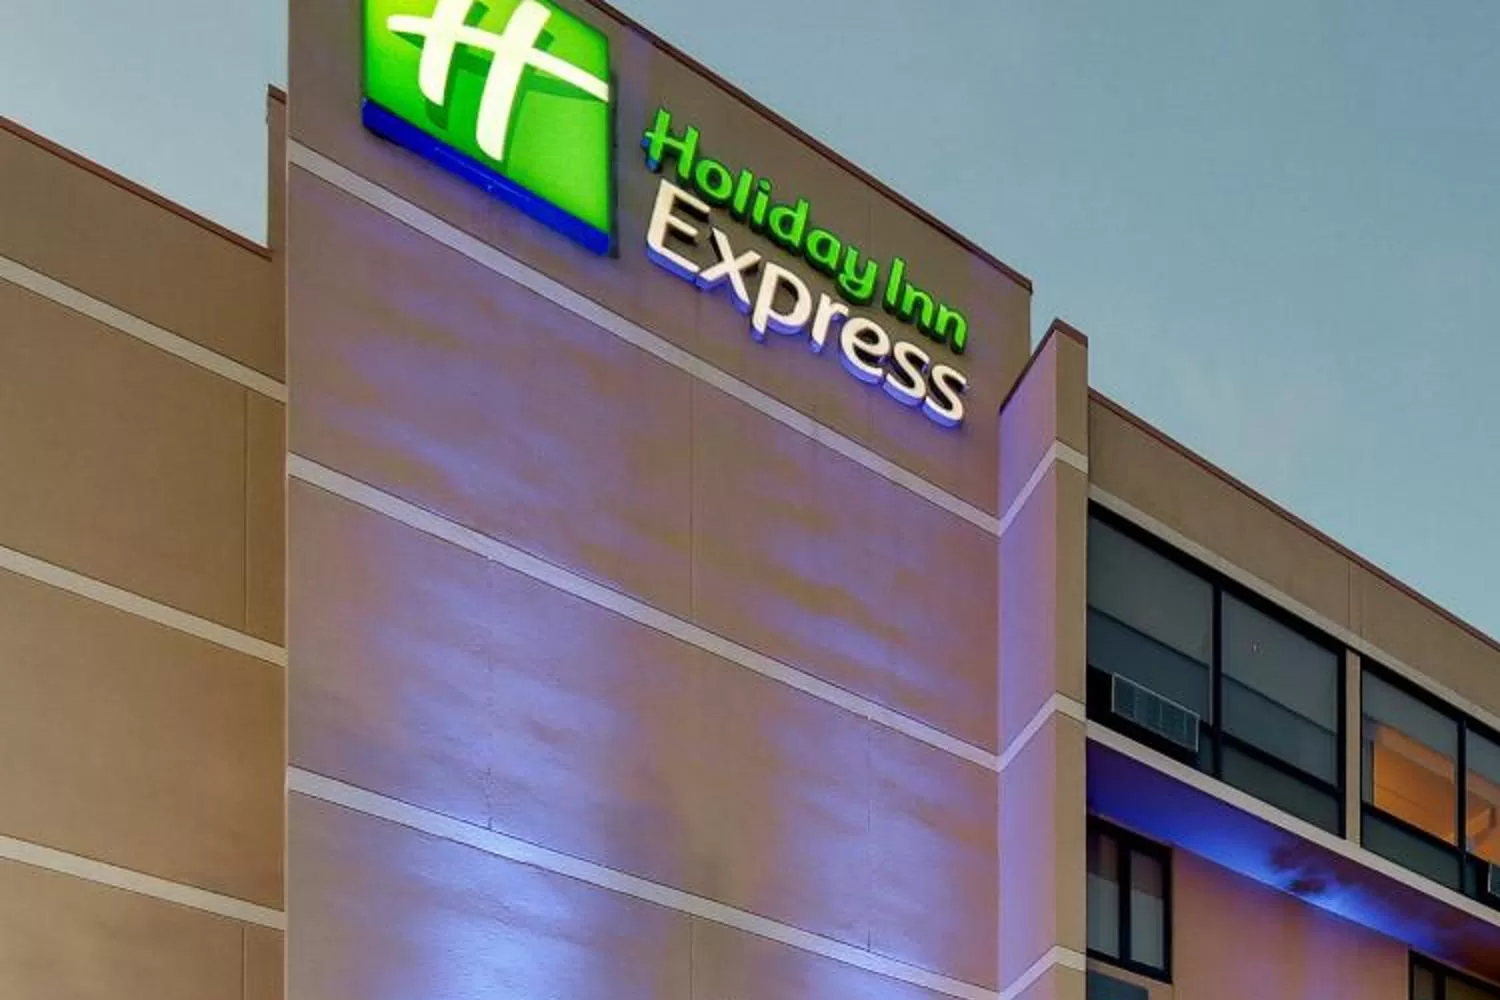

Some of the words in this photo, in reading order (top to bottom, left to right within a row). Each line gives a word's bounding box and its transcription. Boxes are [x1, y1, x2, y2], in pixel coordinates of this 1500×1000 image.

[643, 108, 878, 304] Holiday
[884, 257, 968, 351] Inn
[648, 179, 967, 424] Express
